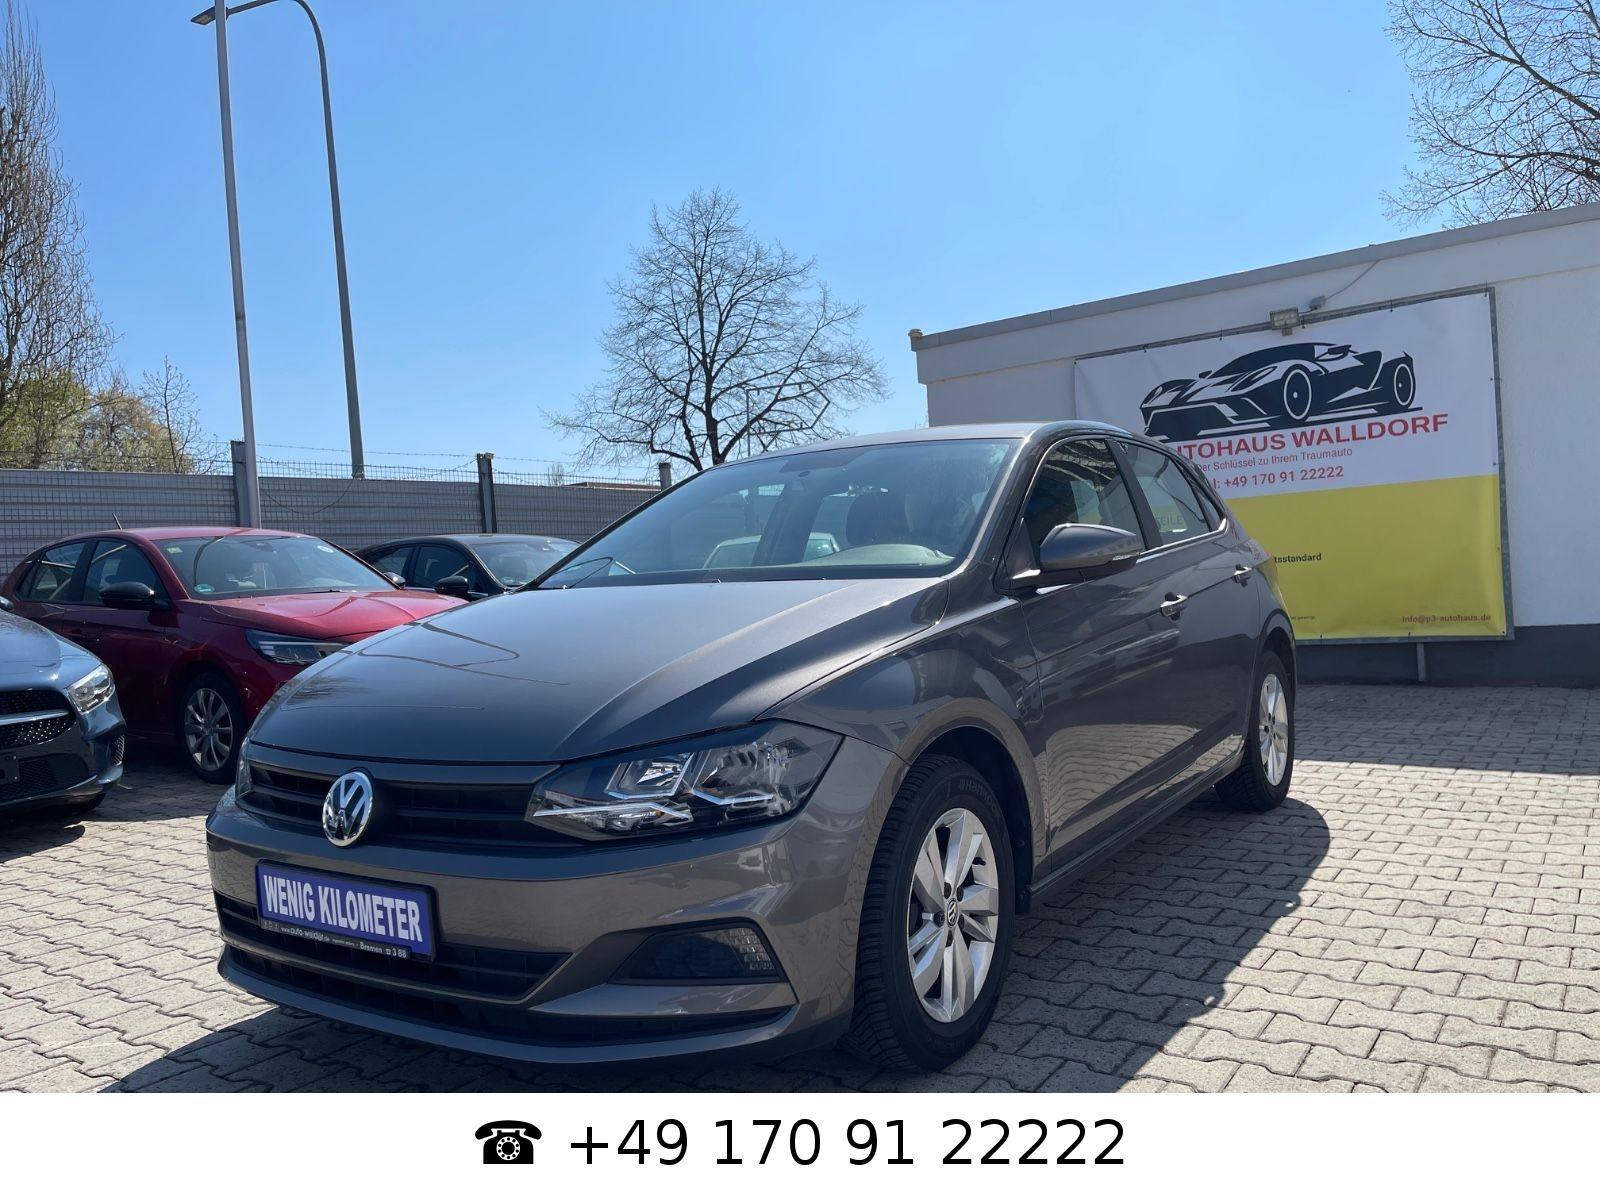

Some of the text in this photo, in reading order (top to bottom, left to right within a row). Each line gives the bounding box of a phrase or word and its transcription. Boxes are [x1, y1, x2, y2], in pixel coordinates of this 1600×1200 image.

[1177, 414, 1449, 460] TOHAUS WALLDORF
[1213, 457, 1256, 471] Schlüssel
[1271, 454, 1298, 464] Ihrem
[1302, 448, 1353, 461] Traumauto
[1224, 475, 1248, 488] +49
[1252, 473, 1276, 485] 170
[1280, 471, 1295, 482] 91
[1300, 465, 1344, 481] 22222
[1273, 552, 1322, 564] tsstandard
[1402, 613, 1492, 624] info@p3-autohaus.de
[263, 875, 424, 943] WENIG KILOMETER
